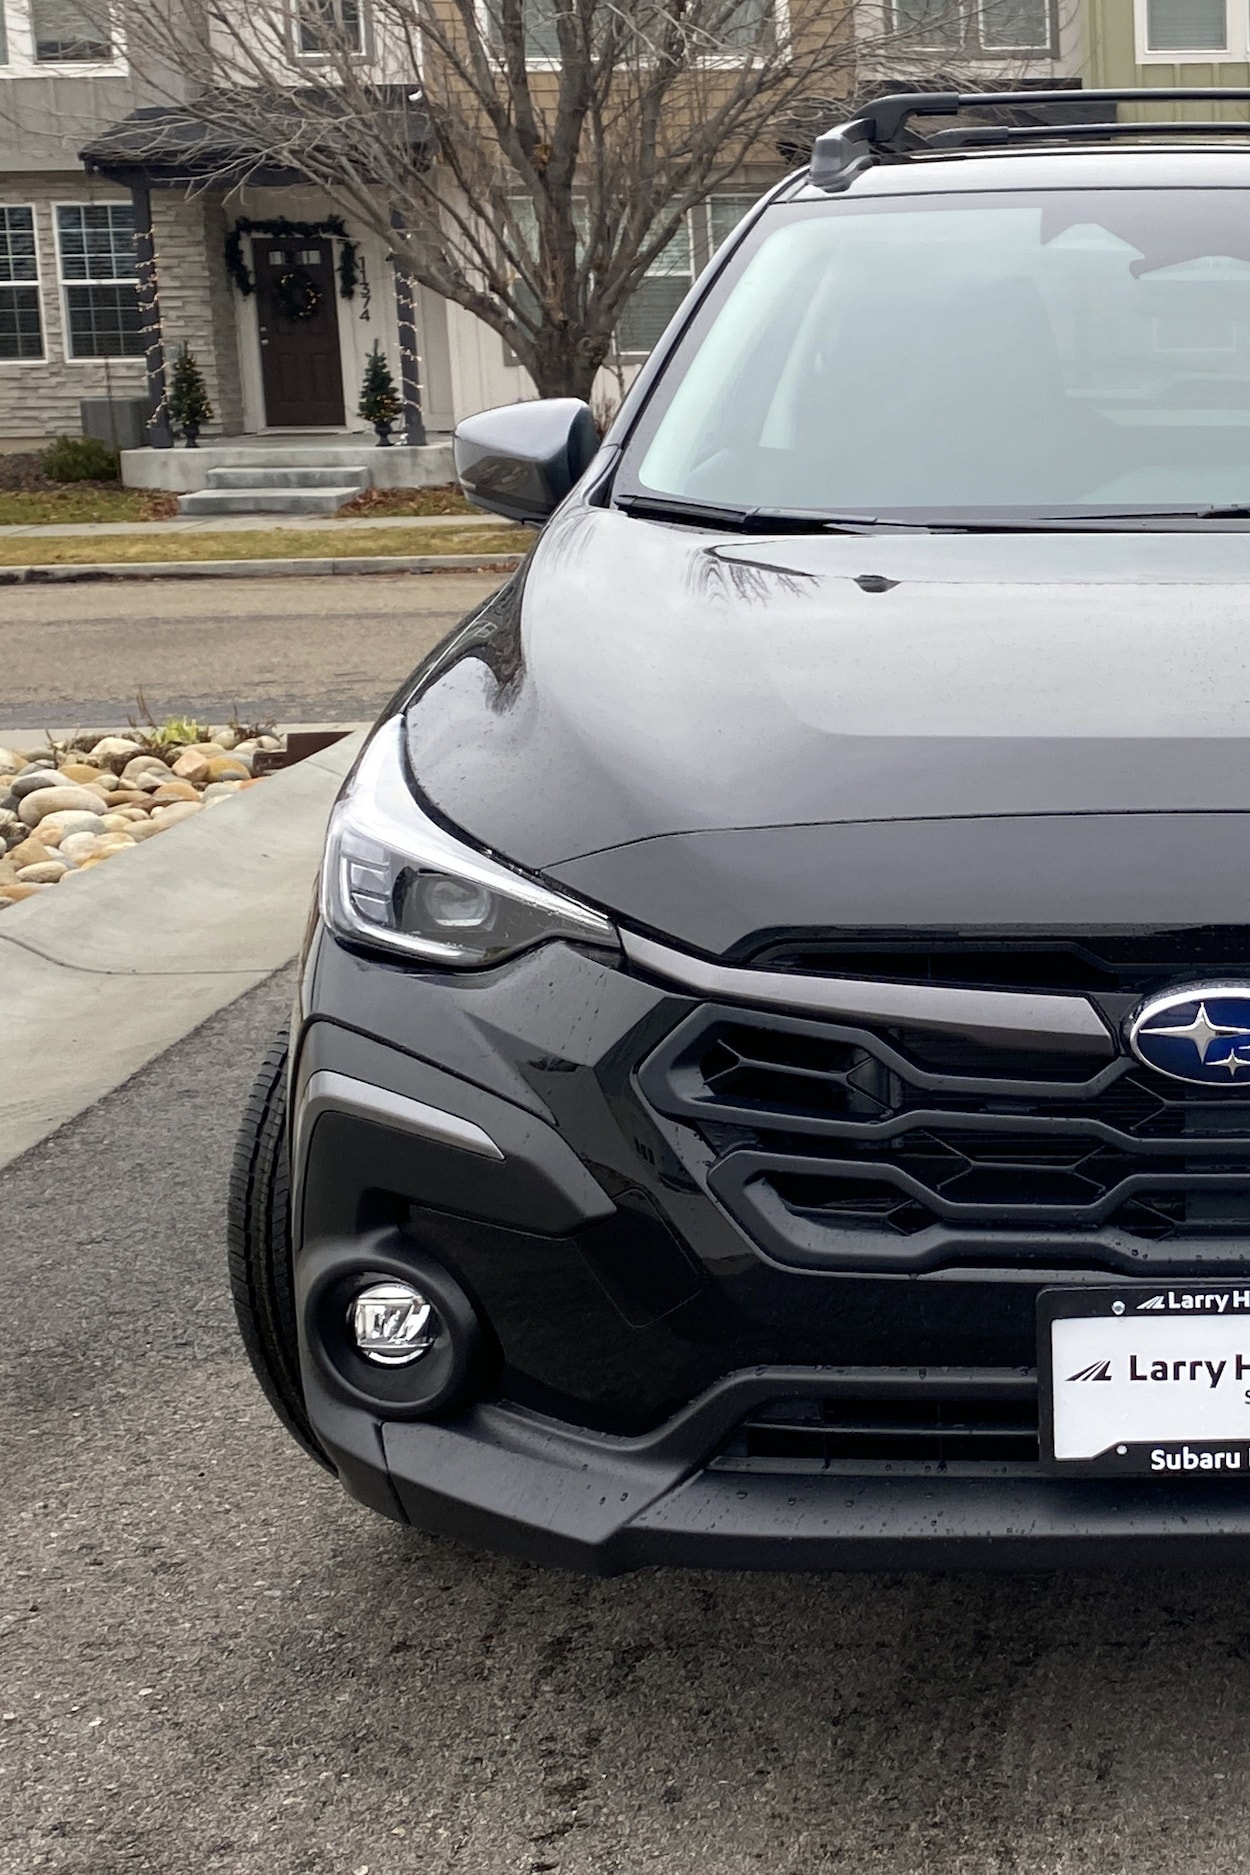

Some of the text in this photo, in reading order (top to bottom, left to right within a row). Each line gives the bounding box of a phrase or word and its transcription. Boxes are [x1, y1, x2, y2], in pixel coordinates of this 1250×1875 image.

[358, 256, 371, 321] 11374
[1168, 1291, 1229, 1312] Larry
[1232, 1290, 1250, 1308] H
[1129, 1355, 1227, 1388] Larry
[1150, 1446, 1241, 1471] Subaru
